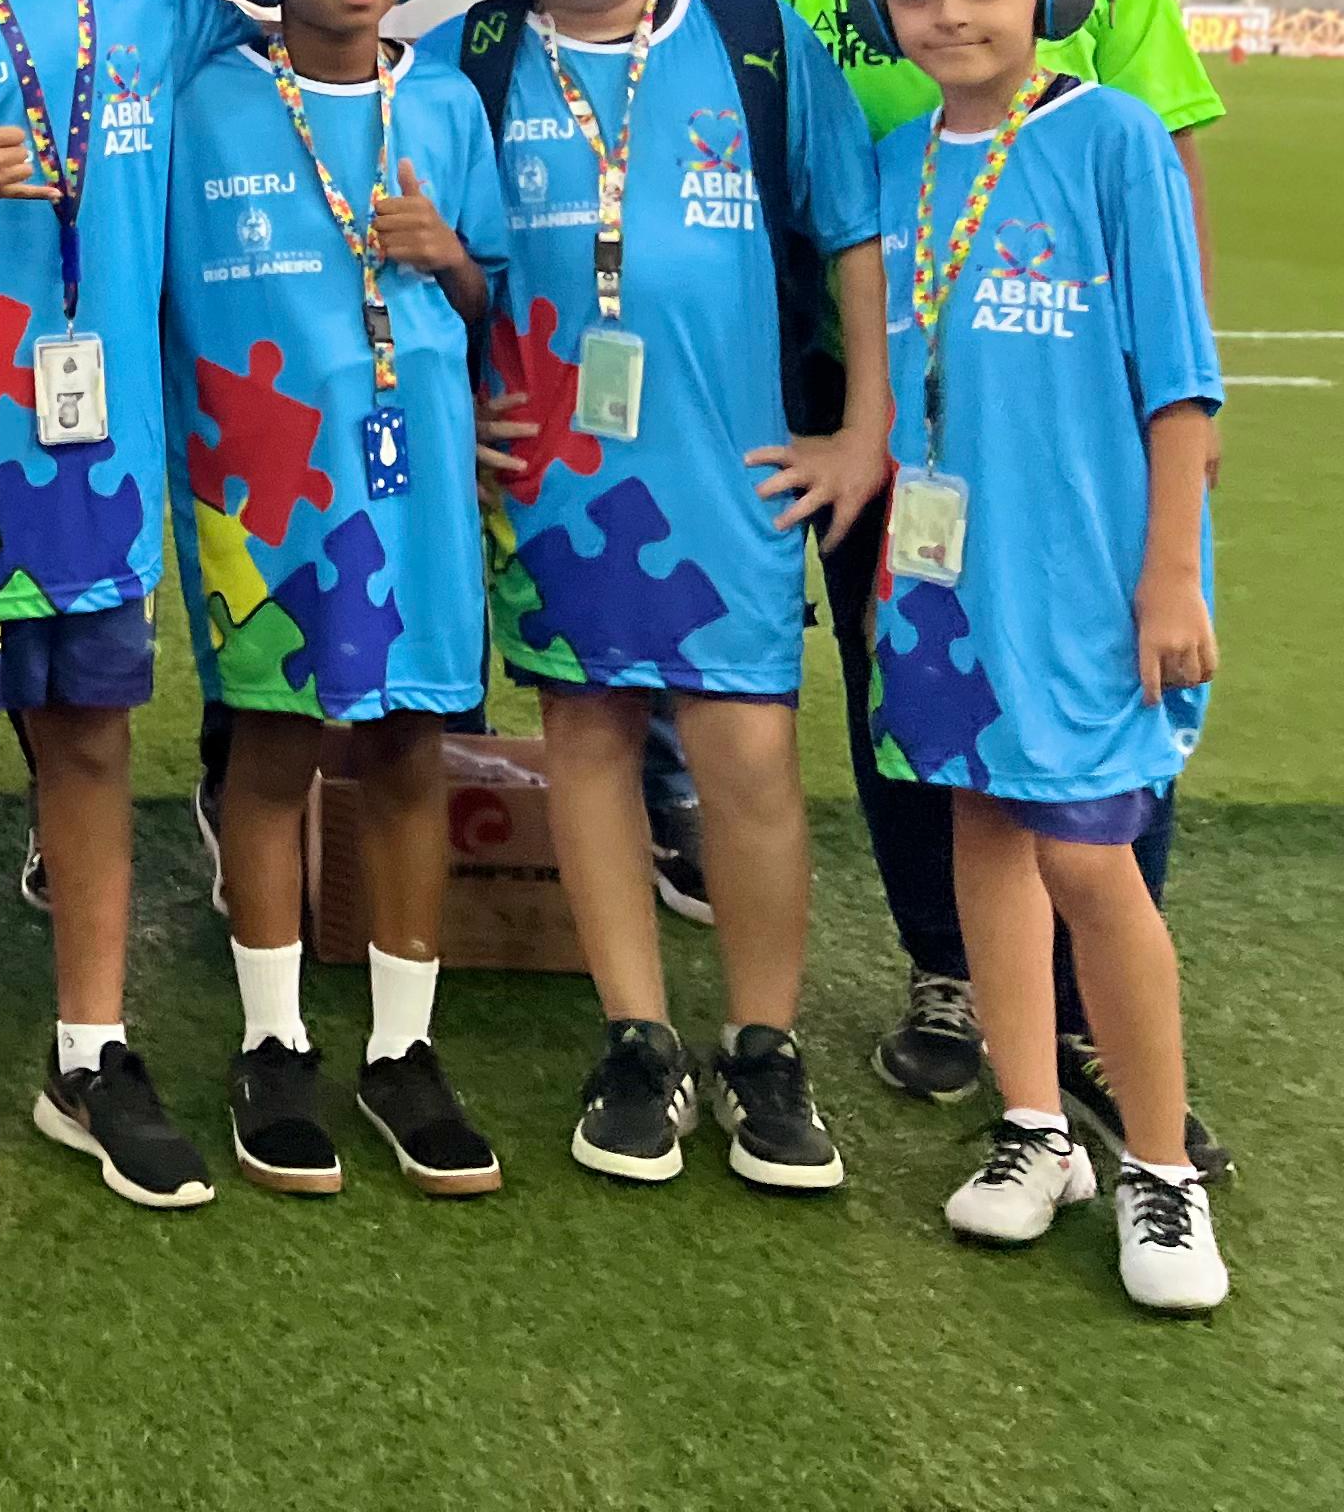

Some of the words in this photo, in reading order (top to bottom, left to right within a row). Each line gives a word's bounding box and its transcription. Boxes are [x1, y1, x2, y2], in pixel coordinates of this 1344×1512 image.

[101, 97, 154, 129] ABRIL
[504, 117, 575, 143] DERJ
[204, 172, 296, 201] SUDERJ
[973, 277, 1090, 312] ABRIL
[971, 304, 1074, 339] AZUL
